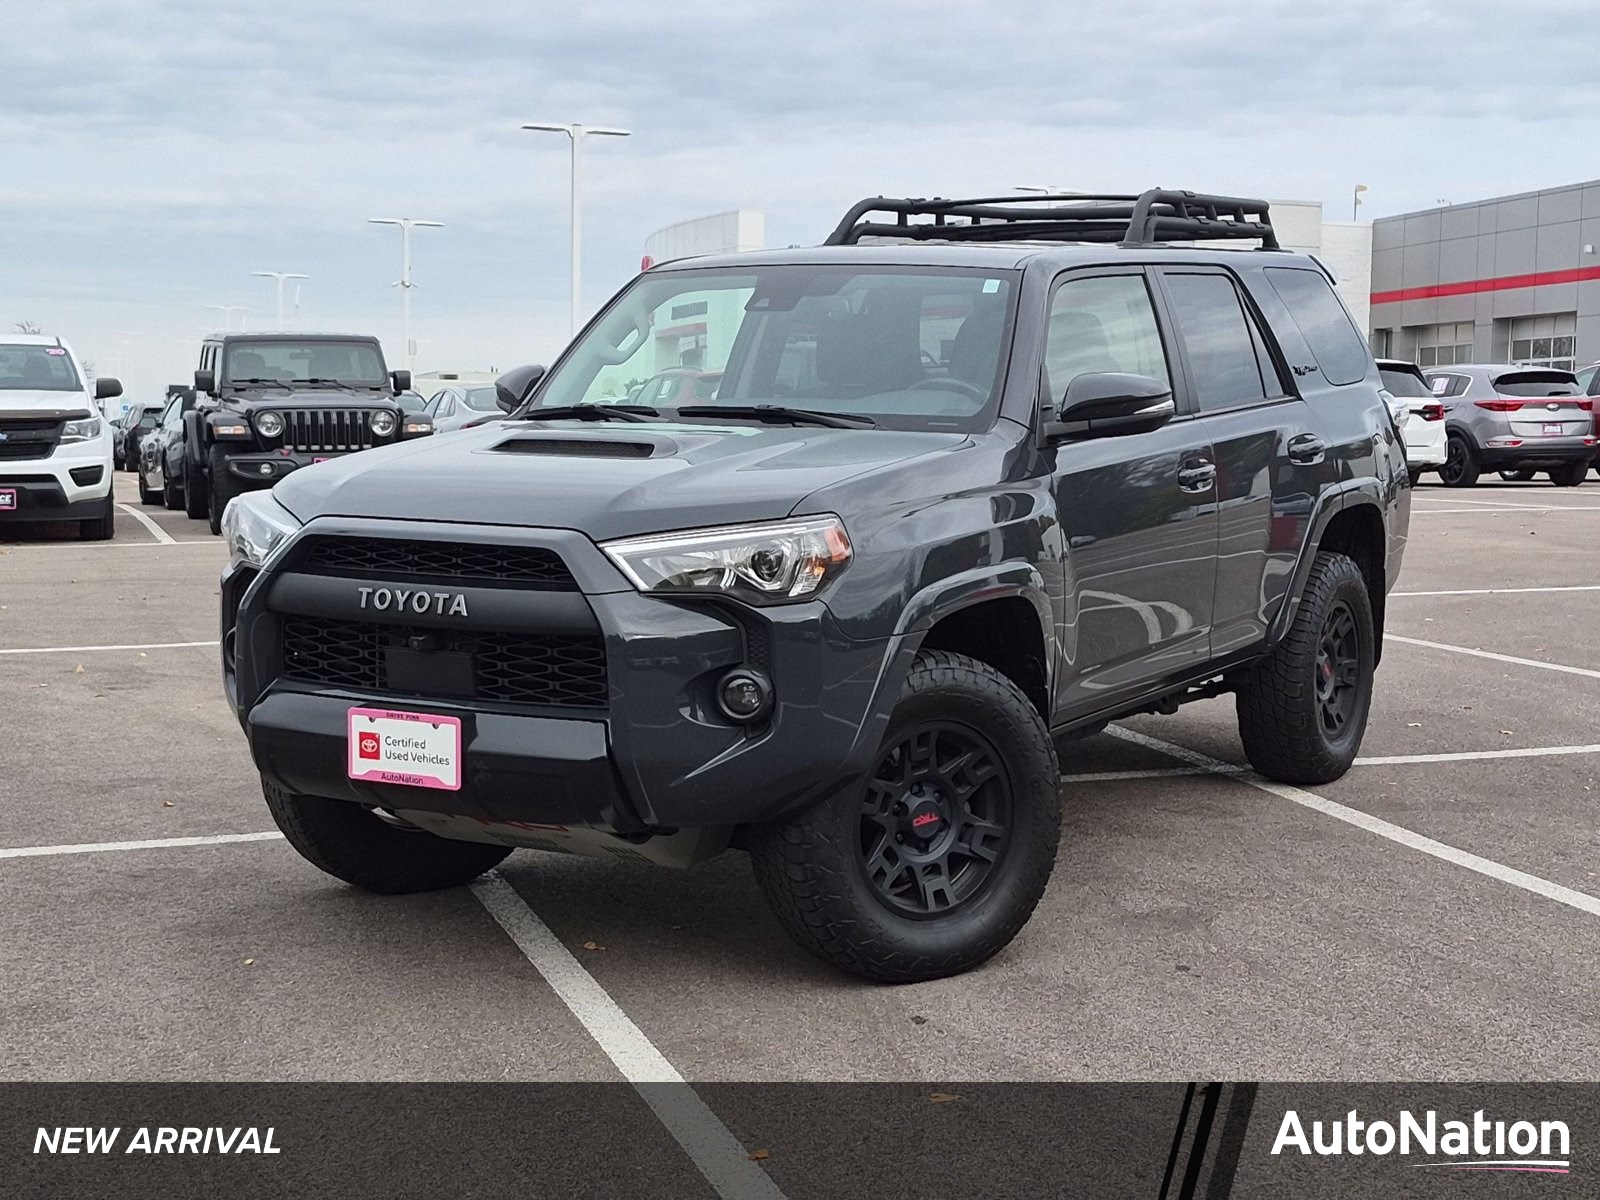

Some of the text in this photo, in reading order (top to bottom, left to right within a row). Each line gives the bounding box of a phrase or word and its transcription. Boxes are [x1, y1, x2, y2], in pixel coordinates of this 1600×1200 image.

[358, 587, 468, 616] TOYOTA
[384, 736, 426, 749] Certified
[384, 749, 450, 766] Used Vehicles
[381, 772, 424, 784] AutoNation
